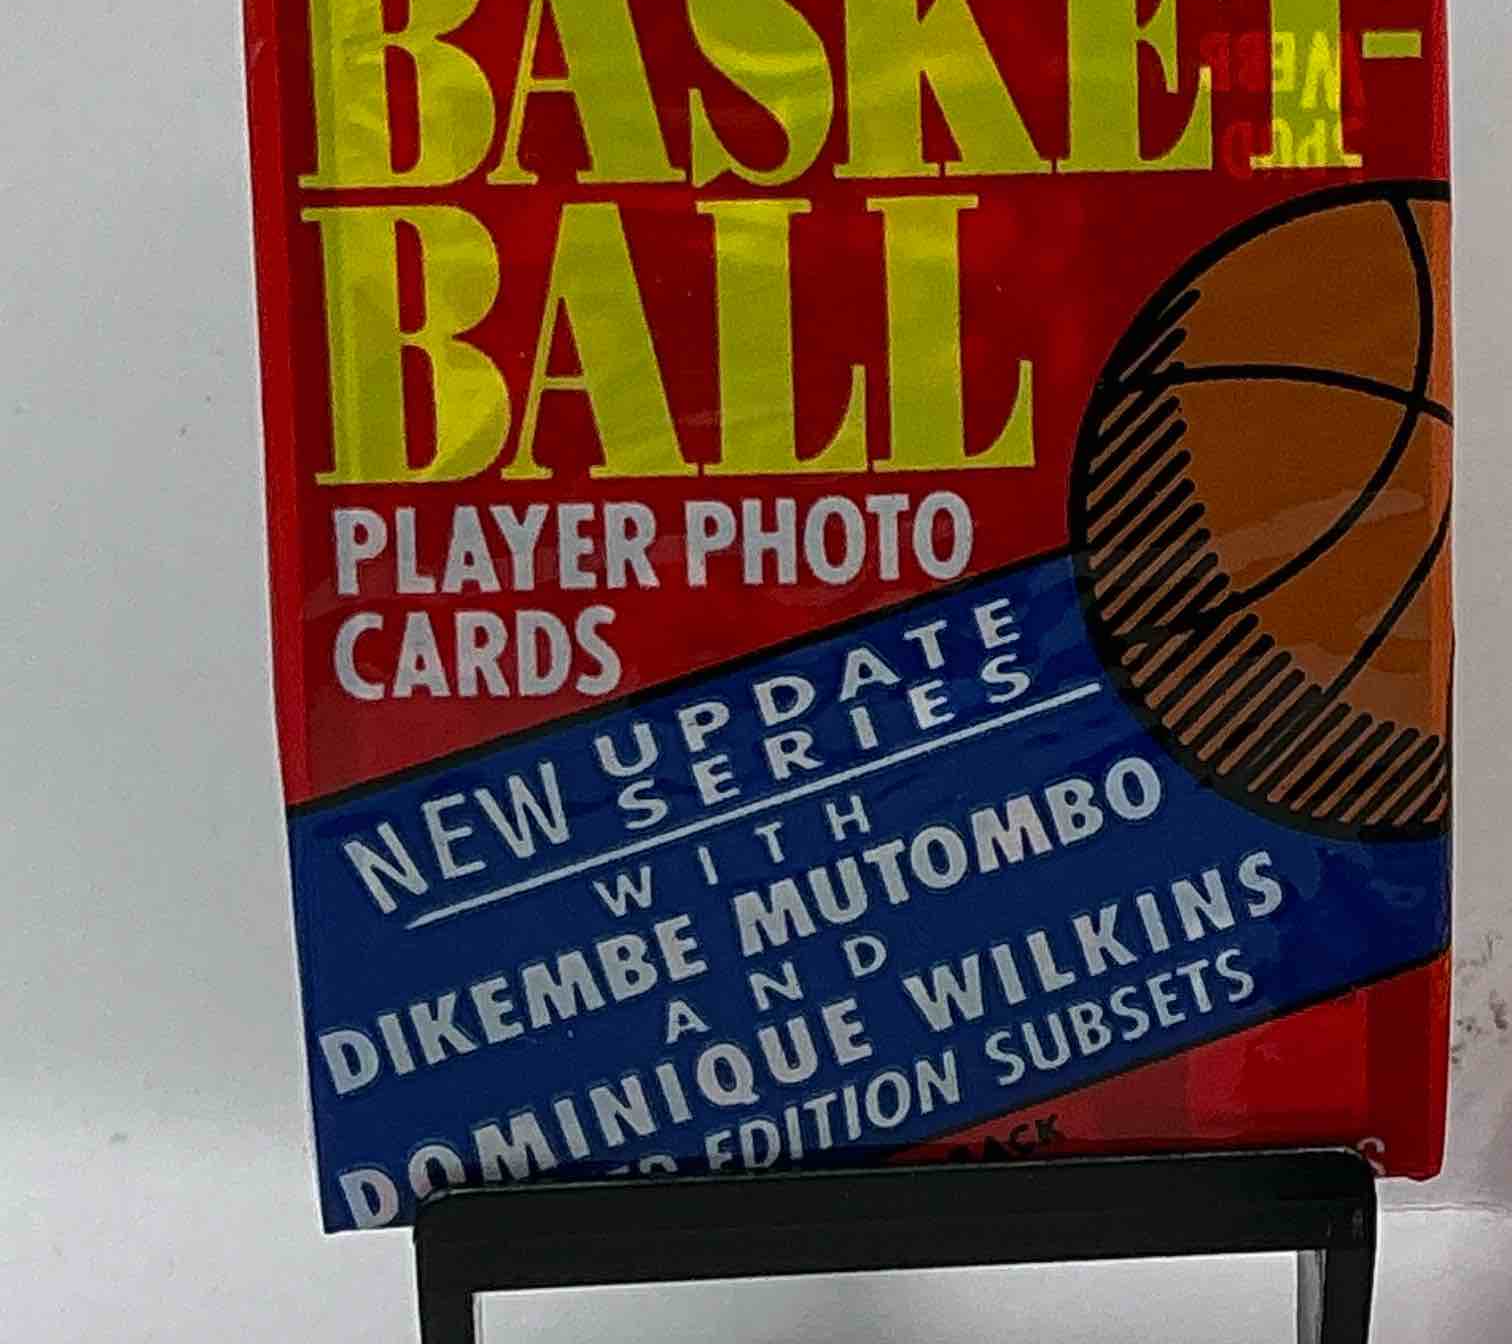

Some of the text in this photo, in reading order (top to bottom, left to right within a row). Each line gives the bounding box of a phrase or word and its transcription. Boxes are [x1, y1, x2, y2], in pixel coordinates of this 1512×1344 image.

[301, 195, 1035, 486] BALL
[333, 490, 974, 596] PLAYER PHOTO
[334, 605, 622, 701] CARDS
[617, 654, 1031, 830] SERIES
[344, 598, 1022, 914] NEW UPDATE
[594, 795, 870, 917] WITH
[318, 757, 1162, 1095] DIKEMBE MUTOMBO
[665, 934, 887, 1044] AND
[338, 851, 1282, 1230] DOMINIQUE WILKINS
[705, 947, 1255, 1173] EDITION SUBSETS
